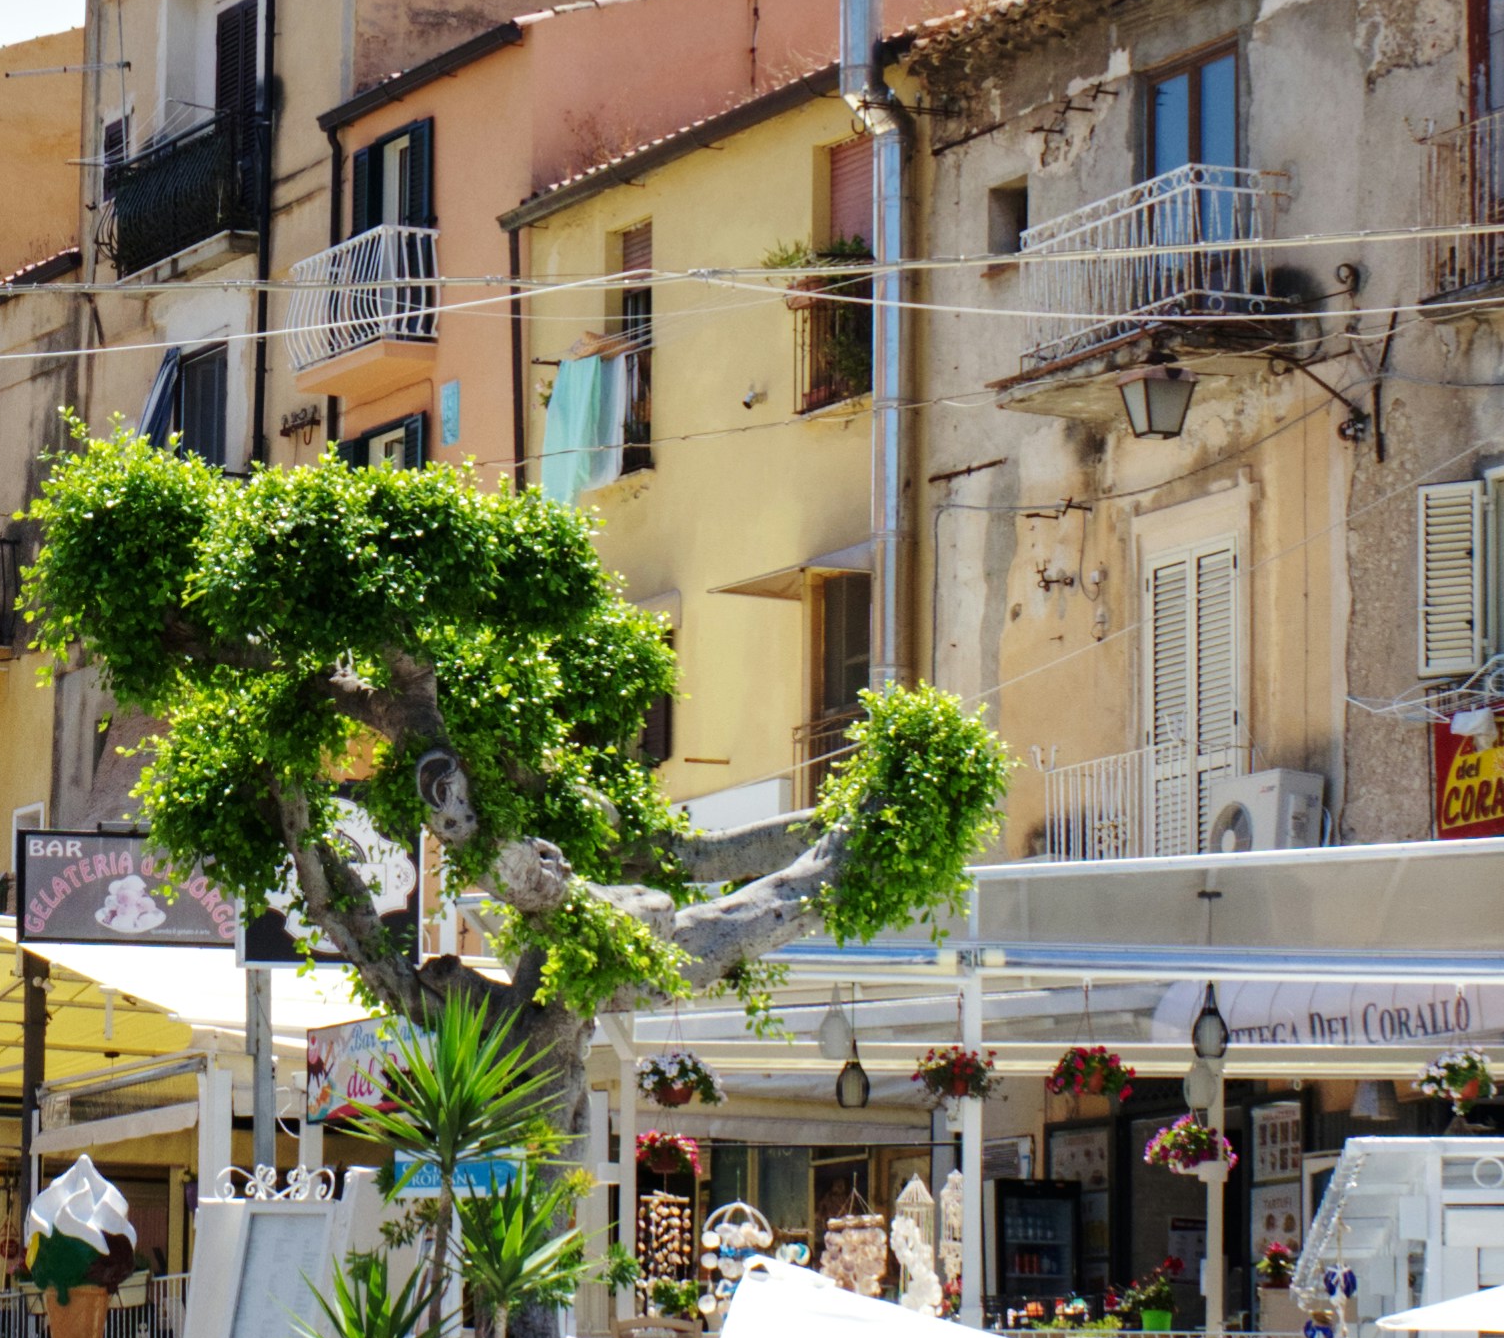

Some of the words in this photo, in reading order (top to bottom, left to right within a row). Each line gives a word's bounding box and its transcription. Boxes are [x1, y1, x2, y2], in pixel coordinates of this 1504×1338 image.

[1455, 756, 1481, 781] del
[29, 839, 83, 857] BAR
[24, 850, 135, 933] GELATERIA
[1362, 994, 1471, 1045] CORALLO
[350, 1025, 378, 1051] Bar
[347, 1059, 375, 1099] del
